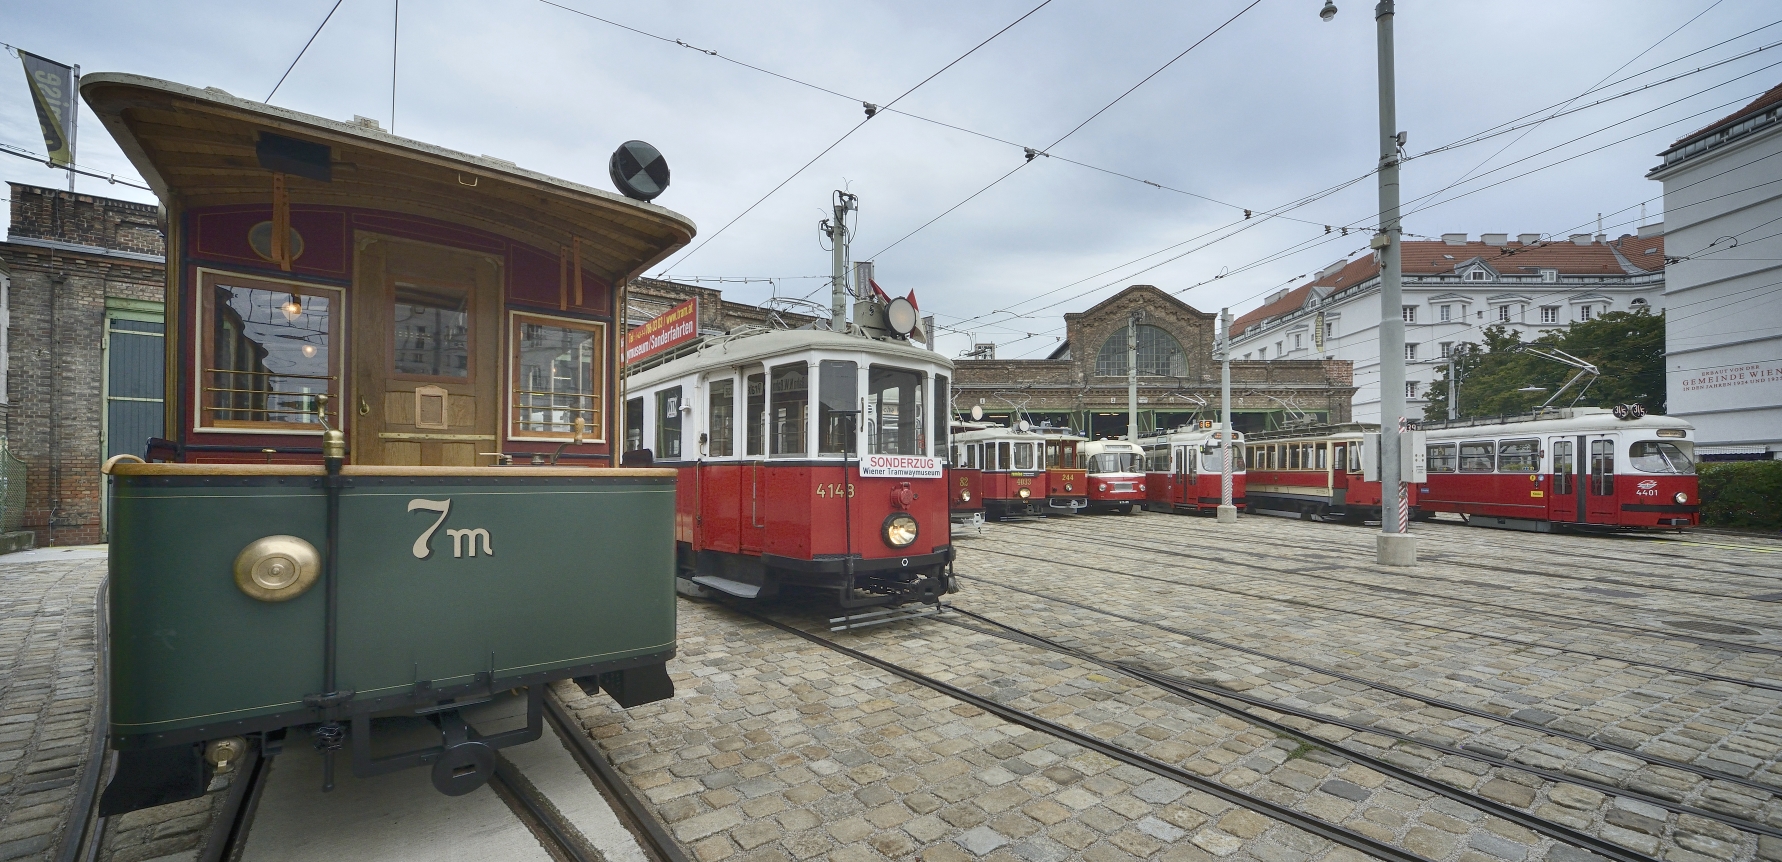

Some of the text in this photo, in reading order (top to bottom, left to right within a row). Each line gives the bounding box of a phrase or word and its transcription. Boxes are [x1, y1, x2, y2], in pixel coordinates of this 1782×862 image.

[1682, 368, 1782, 386] GEMEINDE WIEN
[1705, 381, 1732, 389] JAHREN
[870, 457, 934, 469] SONDERZUG
[862, 467, 940, 477] Wiener Tramwaymuseum
[960, 477, 969, 487] 82
[1016, 478, 1032, 486] 4033
[816, 483, 855, 498] 4148
[408, 498, 493, 558] 7m
